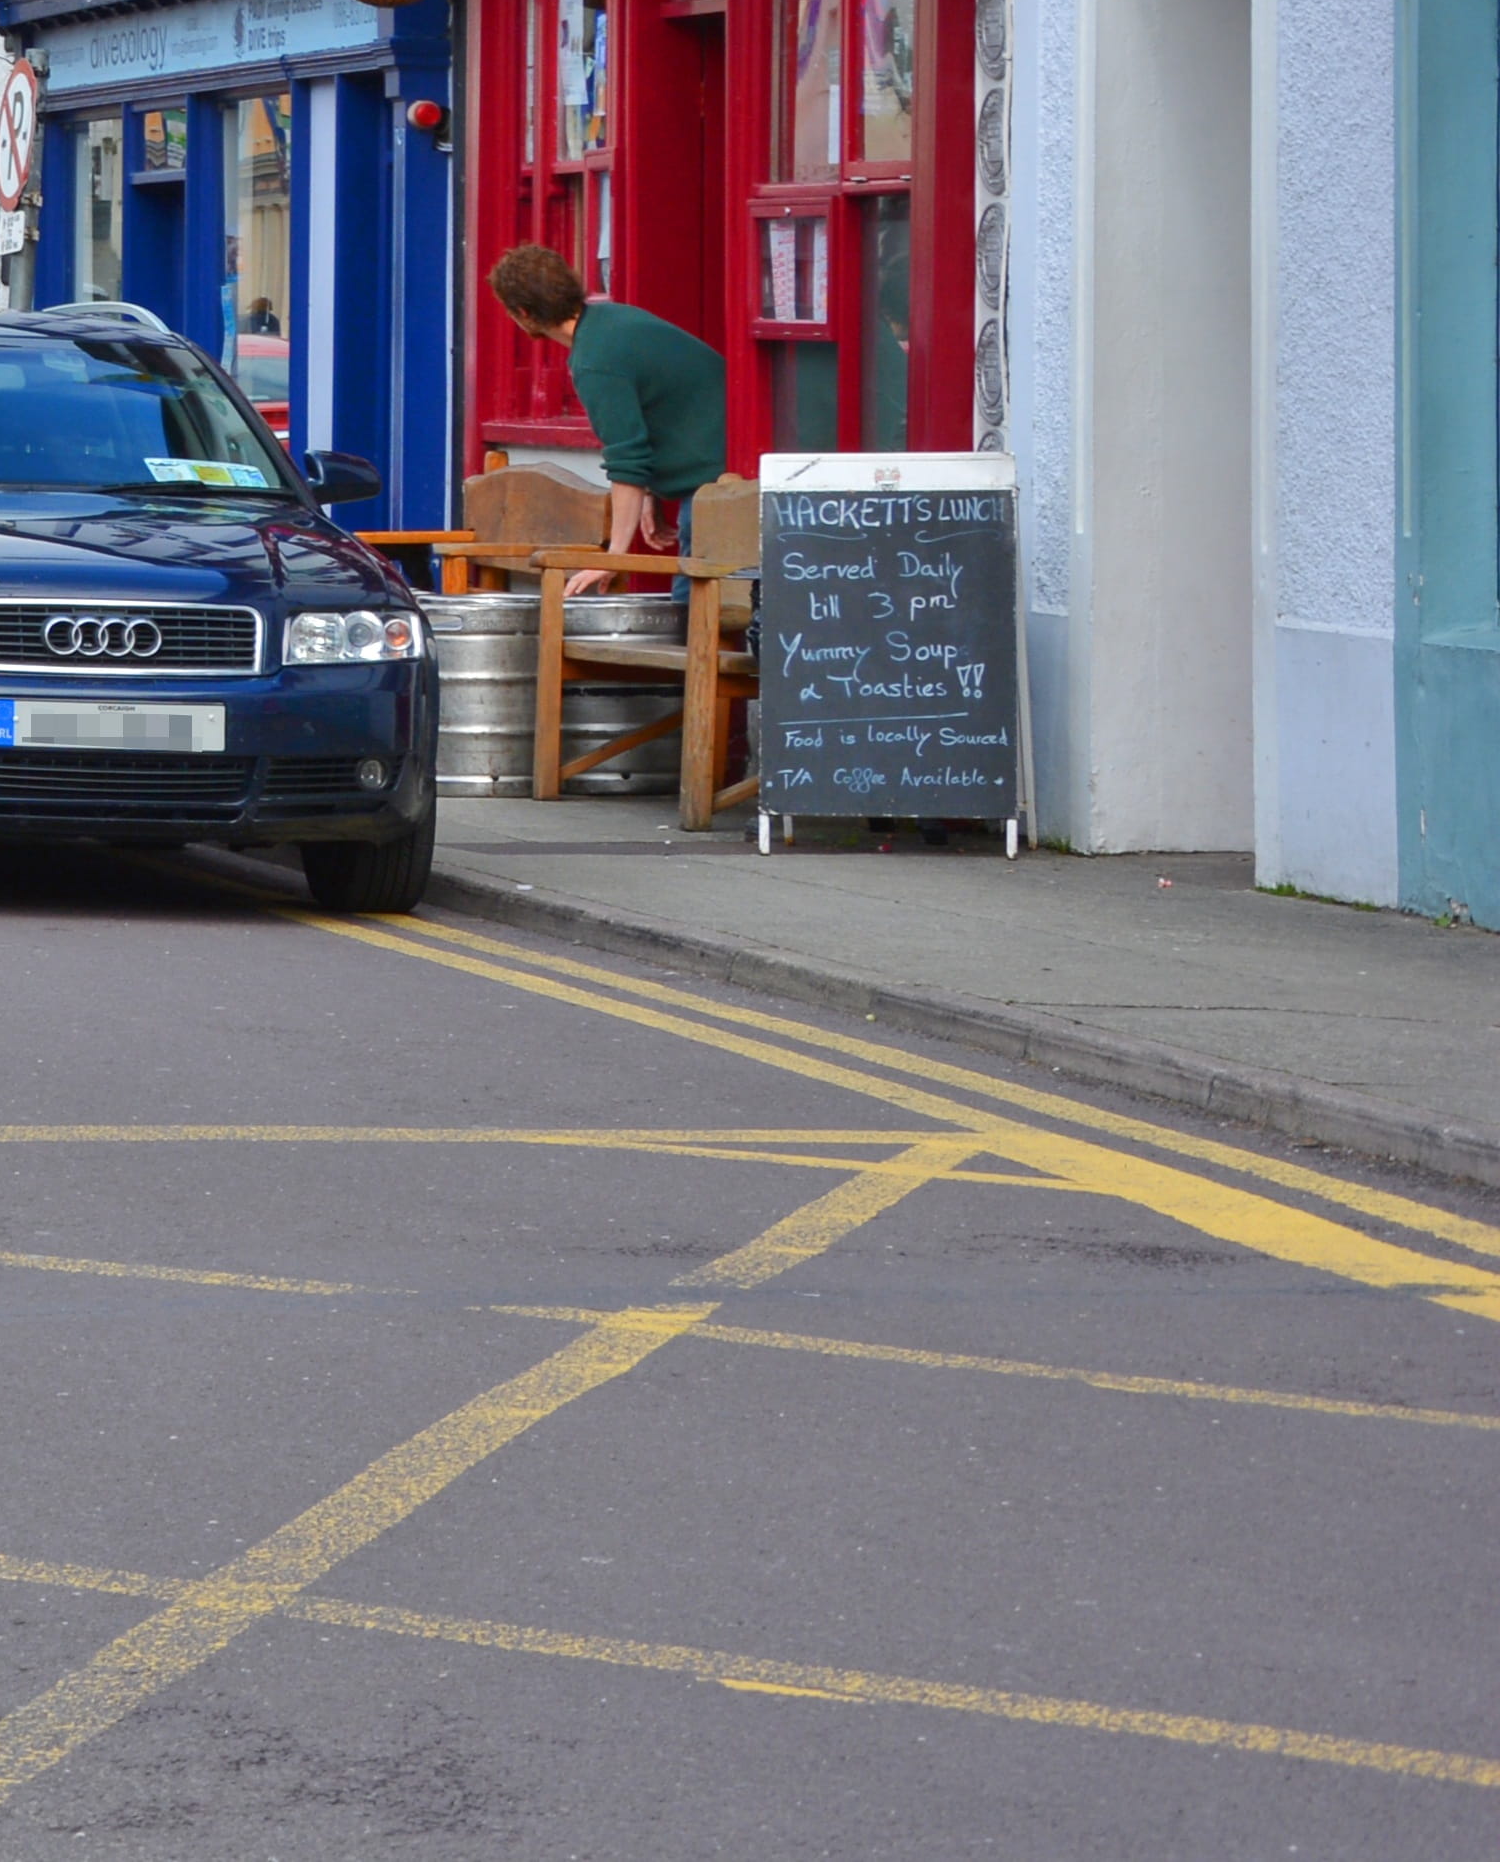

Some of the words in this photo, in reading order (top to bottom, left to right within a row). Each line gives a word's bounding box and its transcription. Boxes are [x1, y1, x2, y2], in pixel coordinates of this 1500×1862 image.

[773, 495, 932, 531] HACKETT'S
[938, 496, 1004, 523] LUNCH
[783, 552, 875, 581] Served
[897, 552, 964, 599] Daily
[810, 592, 840, 621] till
[867, 592, 894, 619] 3
[910, 595, 957, 621] pm
[778, 632, 871, 681] Yummy
[885, 631, 958, 670] Soup
[826, 674, 948, 700] Toasties
[785, 729, 823, 748] Food
[840, 729, 857, 746] is
[867, 725, 932, 756] locally
[939, 726, 1009, 747] Sourced
[777, 768, 812, 787] T/A
[833, 767, 887, 793] Coffee
[900, 767, 987, 787] Available
